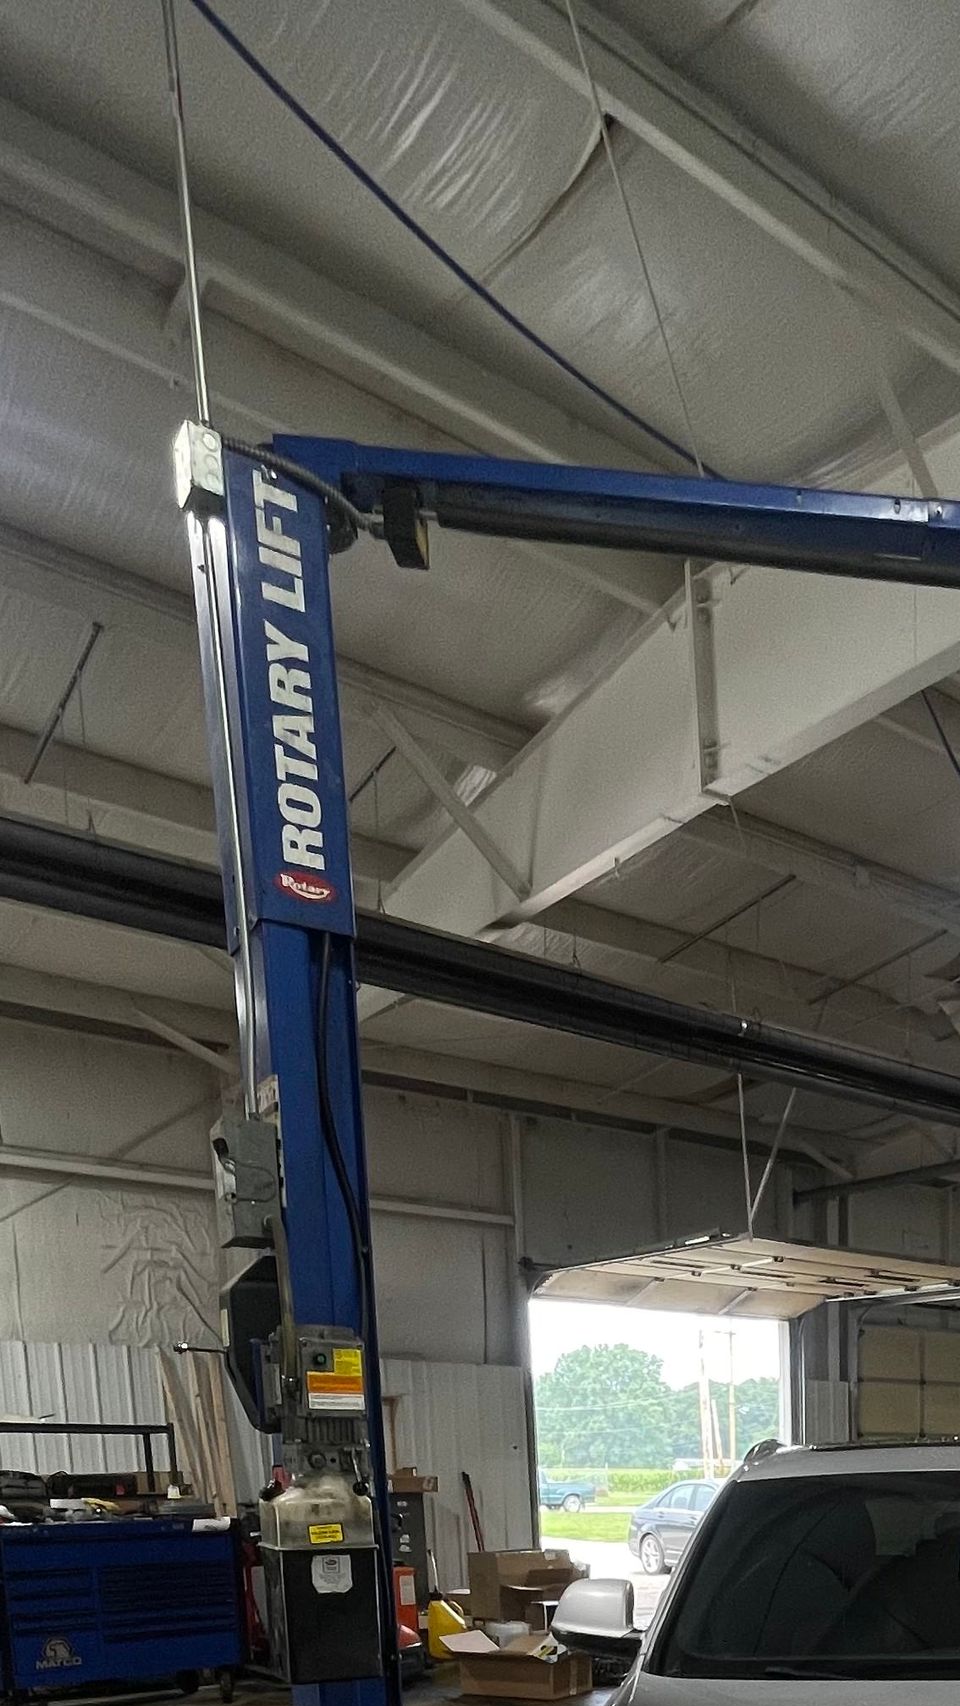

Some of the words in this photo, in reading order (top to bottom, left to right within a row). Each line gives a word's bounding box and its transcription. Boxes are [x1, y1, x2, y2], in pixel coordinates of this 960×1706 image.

[253, 468, 306, 613] LIFT
[266, 620, 326, 870] ROTARY
[280, 873, 330, 899] Rotary
[36, 1656, 82, 1671] MATCO
